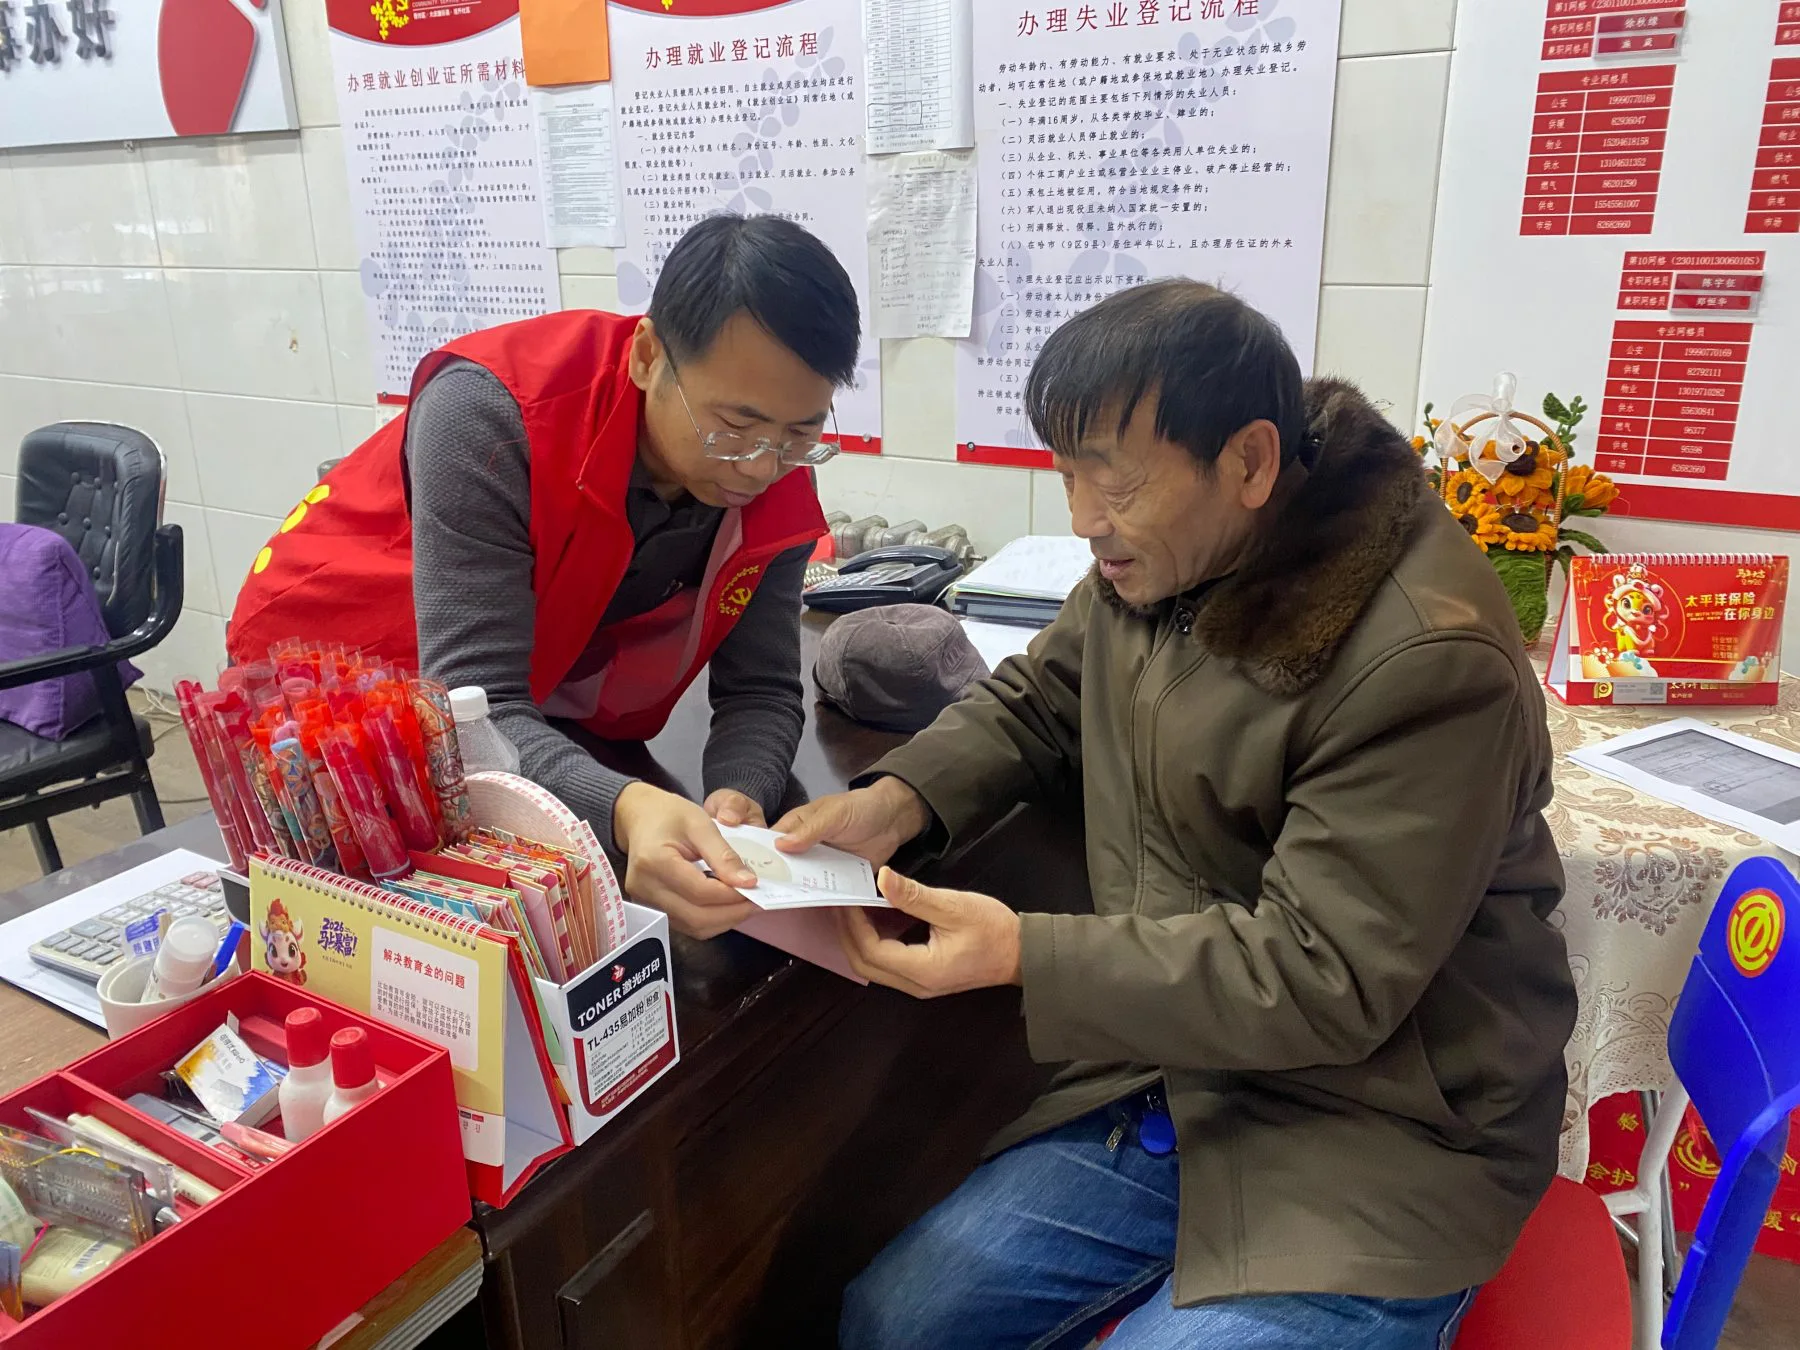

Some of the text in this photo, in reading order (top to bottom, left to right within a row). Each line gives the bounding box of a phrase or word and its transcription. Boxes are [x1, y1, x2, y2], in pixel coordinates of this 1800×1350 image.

[1017, 0, 1259, 37] 办理失业登记流程
[646, 32, 819, 69] 办理就业登记流程
[347, 57, 526, 93] 办理就业创业证所需材料
[1581, 72, 1629, 87] 专业网格员
[1551, 98, 1568, 109] 公安
[1778, 130, 1796, 141] 物业
[1545, 139, 1562, 150] 物业
[1774, 152, 1793, 163] 供水
[1543, 160, 1560, 171] 供水
[1538, 201, 1555, 211] 供电
[1767, 195, 1786, 206] 供电
[977, 258, 1021, 268] 失业人员。
[1656, 326, 1705, 337] 专业网格员
[1625, 345, 1644, 355] 公安
[1620, 384, 1638, 394] 物业
[1618, 402, 1634, 413] 供水
[1685, 592, 1756, 608] 太平洋保险
[1724, 606, 1775, 621] 在你身边
[322, 917, 344, 933] 2026
[383, 948, 465, 989] 解决教育金的问题
[577, 957, 661, 1027] TONER 激光打印
